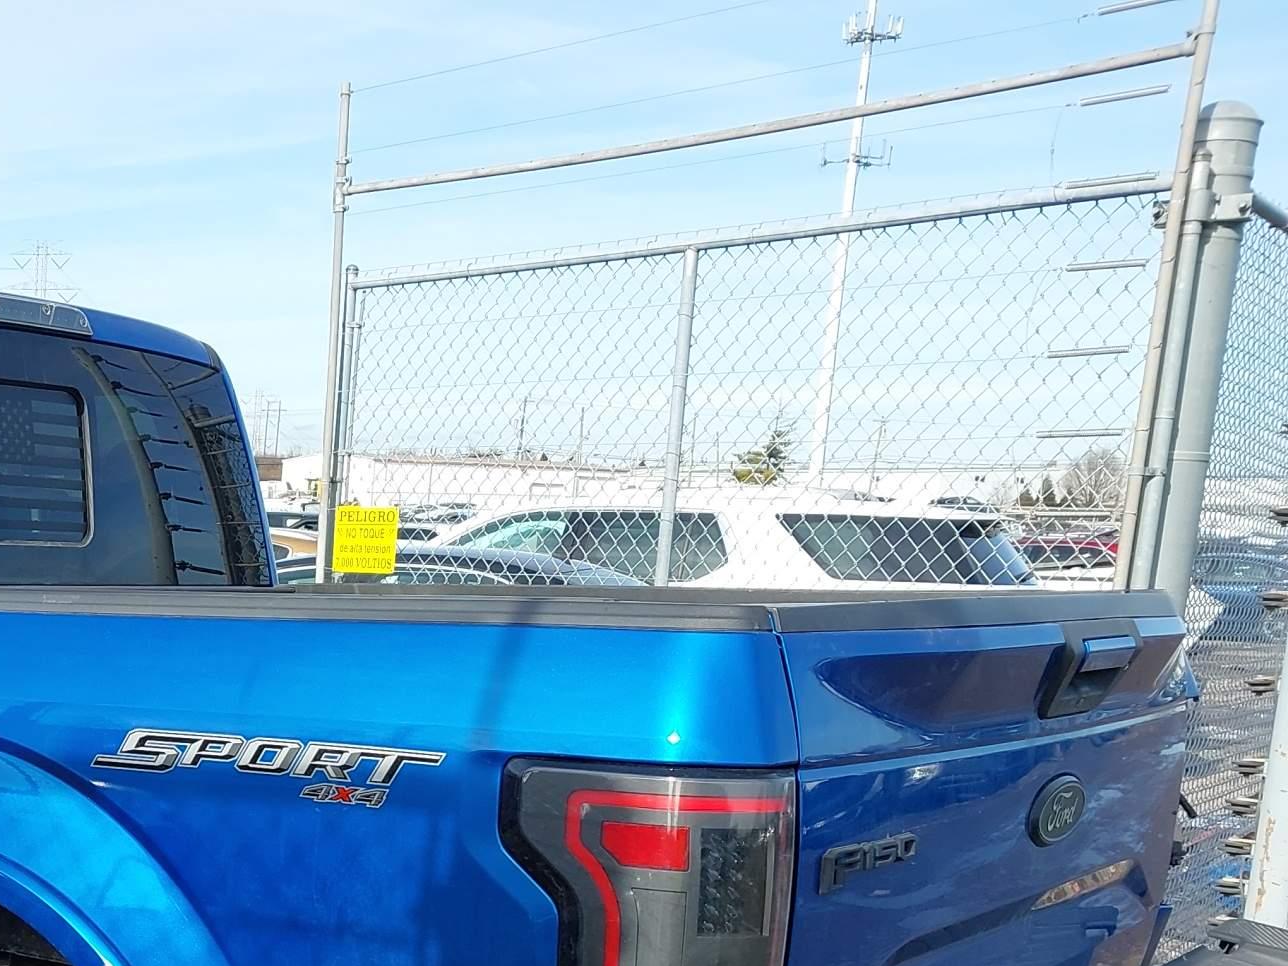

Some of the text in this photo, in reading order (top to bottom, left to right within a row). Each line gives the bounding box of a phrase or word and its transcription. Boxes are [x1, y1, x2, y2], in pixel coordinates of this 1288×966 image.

[339, 510, 396, 523] PELIGRO
[345, 528, 385, 539] NO TOQUE
[356, 557, 392, 570] VOLTIOS
[90, 728, 446, 785] SPORT
[1047, 791, 1078, 832] Ford
